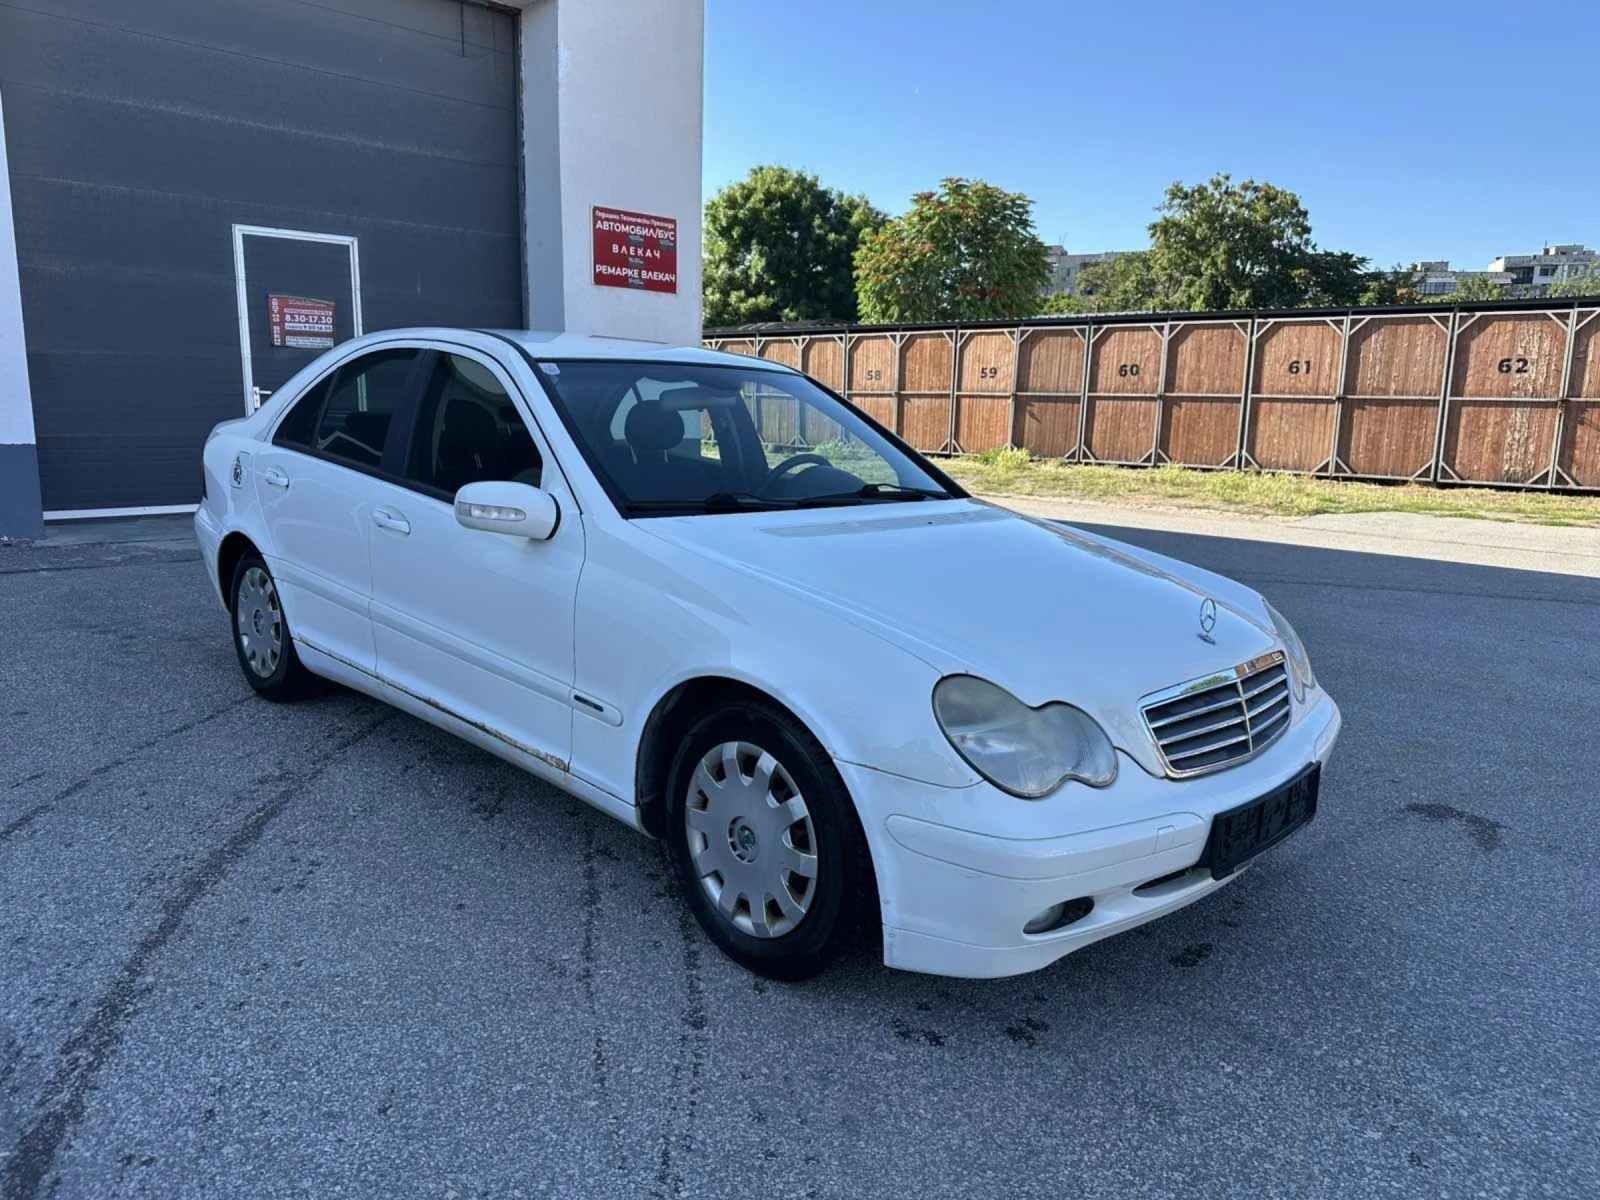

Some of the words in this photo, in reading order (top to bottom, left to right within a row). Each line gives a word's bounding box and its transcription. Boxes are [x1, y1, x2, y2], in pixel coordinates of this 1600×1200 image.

[595, 220, 675, 240] АВТОМОБИЛ/БУС
[612, 244, 660, 259] ВЛЕКАЧ
[595, 264, 640, 278] РЕМАРКЕ
[641, 270, 675, 283] ВЛЕКАЧ
[285, 314, 333, 324] 8.30-17.30
[980, 366, 998, 379] 59
[1119, 363, 1140, 377] 60
[1288, 360, 1311, 375] 61
[1497, 357, 1529, 374] 62
[866, 369, 882, 381] 58
